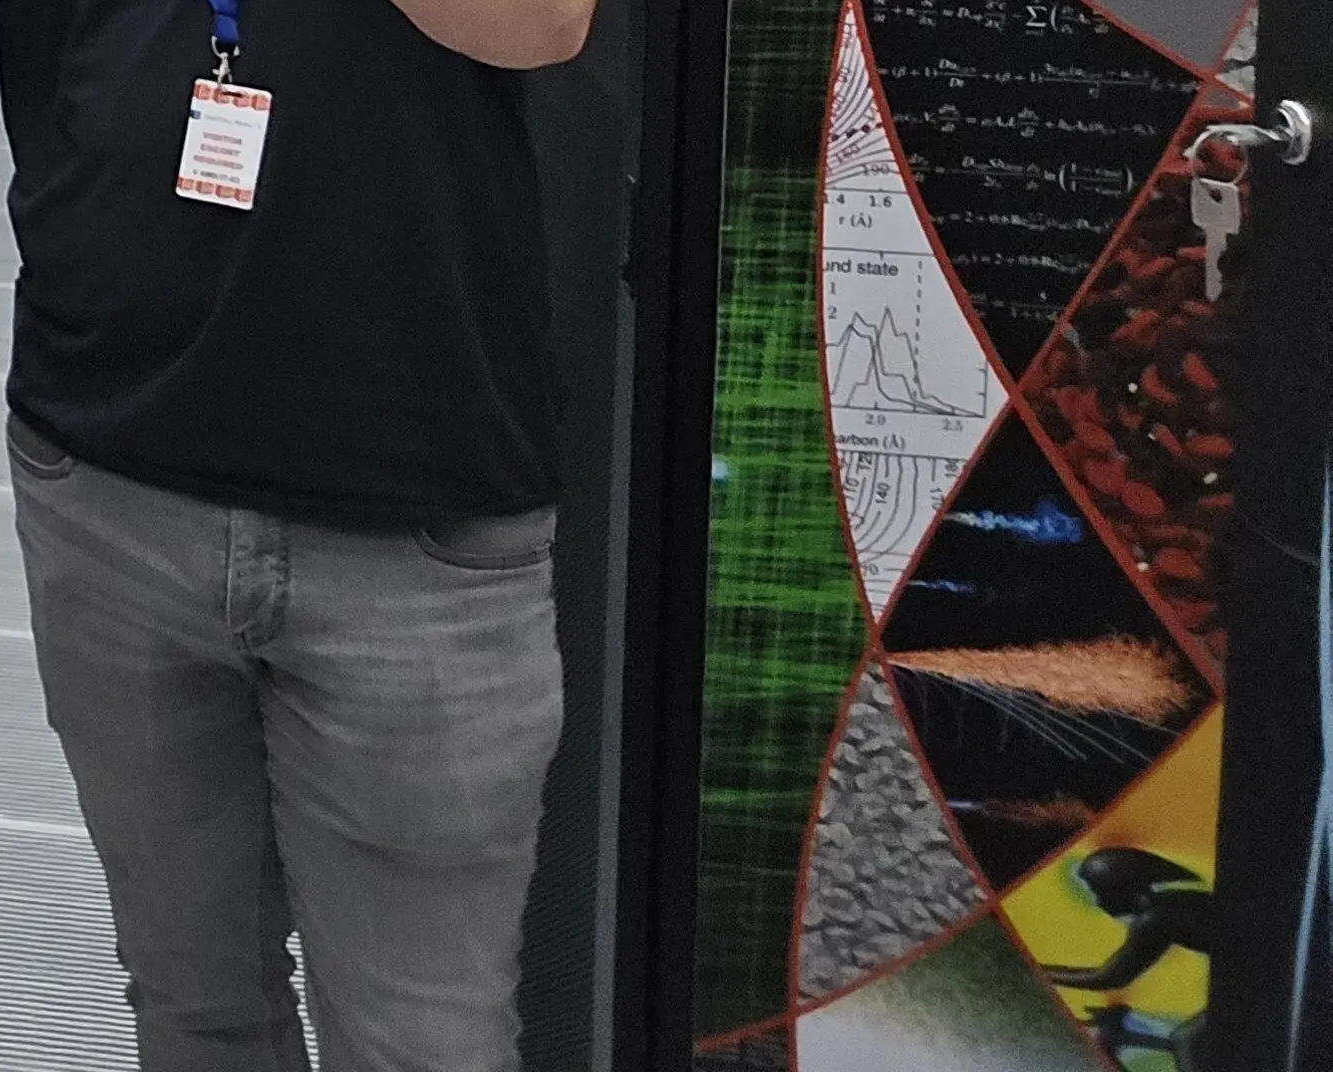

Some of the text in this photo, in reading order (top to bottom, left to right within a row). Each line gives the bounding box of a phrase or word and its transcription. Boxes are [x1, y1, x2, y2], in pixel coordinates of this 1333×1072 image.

[869, 195, 893, 208] 1.6
[856, 261, 899, 276] state
[835, 433, 879, 447] arbon
